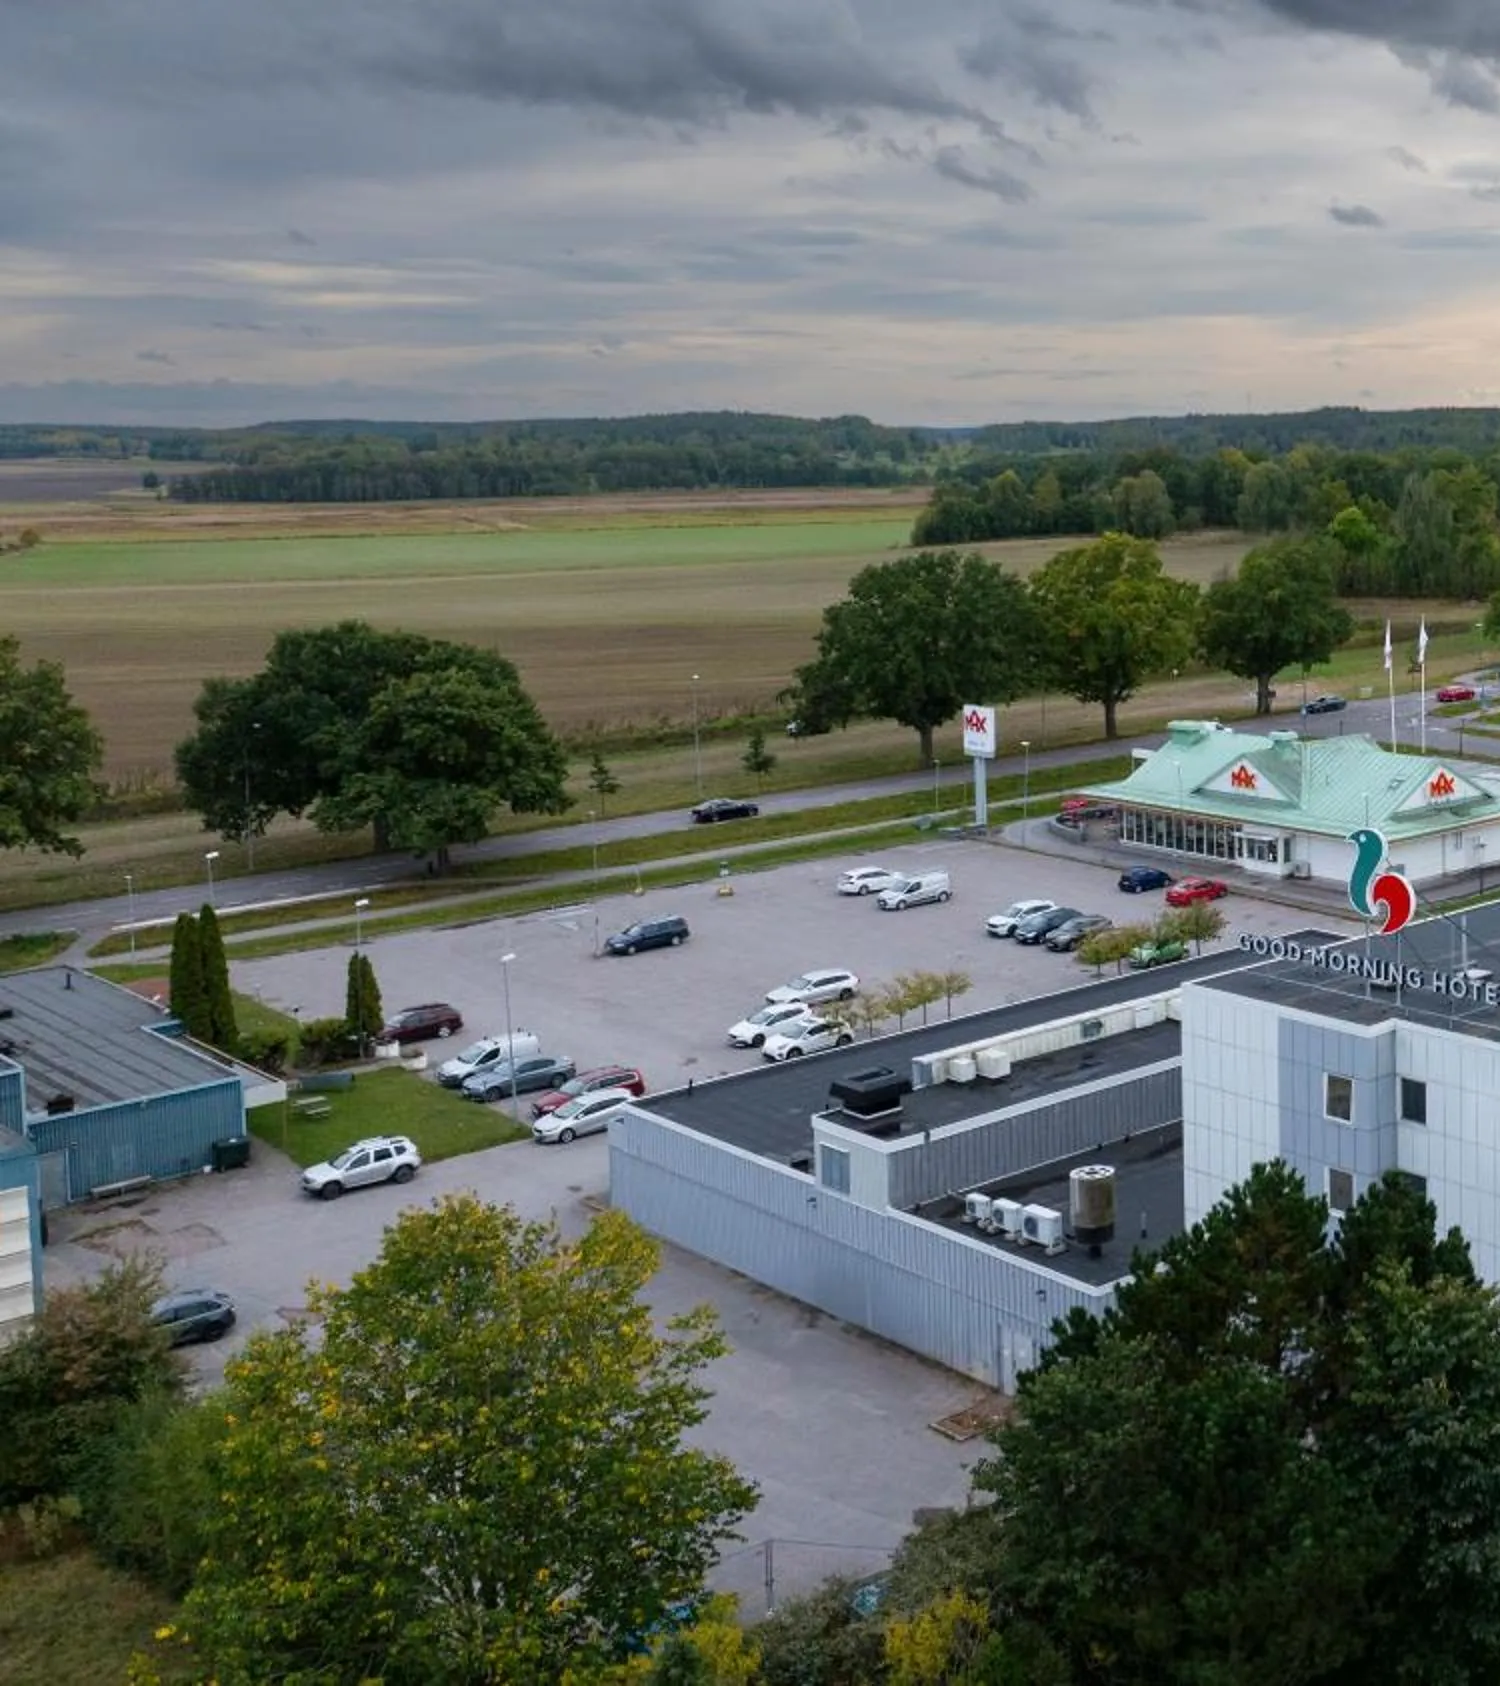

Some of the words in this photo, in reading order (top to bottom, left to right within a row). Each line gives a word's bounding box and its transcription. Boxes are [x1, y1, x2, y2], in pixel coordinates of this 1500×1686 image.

[966, 710, 987, 733] MAX
[1232, 765, 1256, 789] MAX
[1430, 771, 1455, 797] MAX
[1238, 933, 1304, 961] GOOD
[1310, 947, 1424, 989] MORNING
